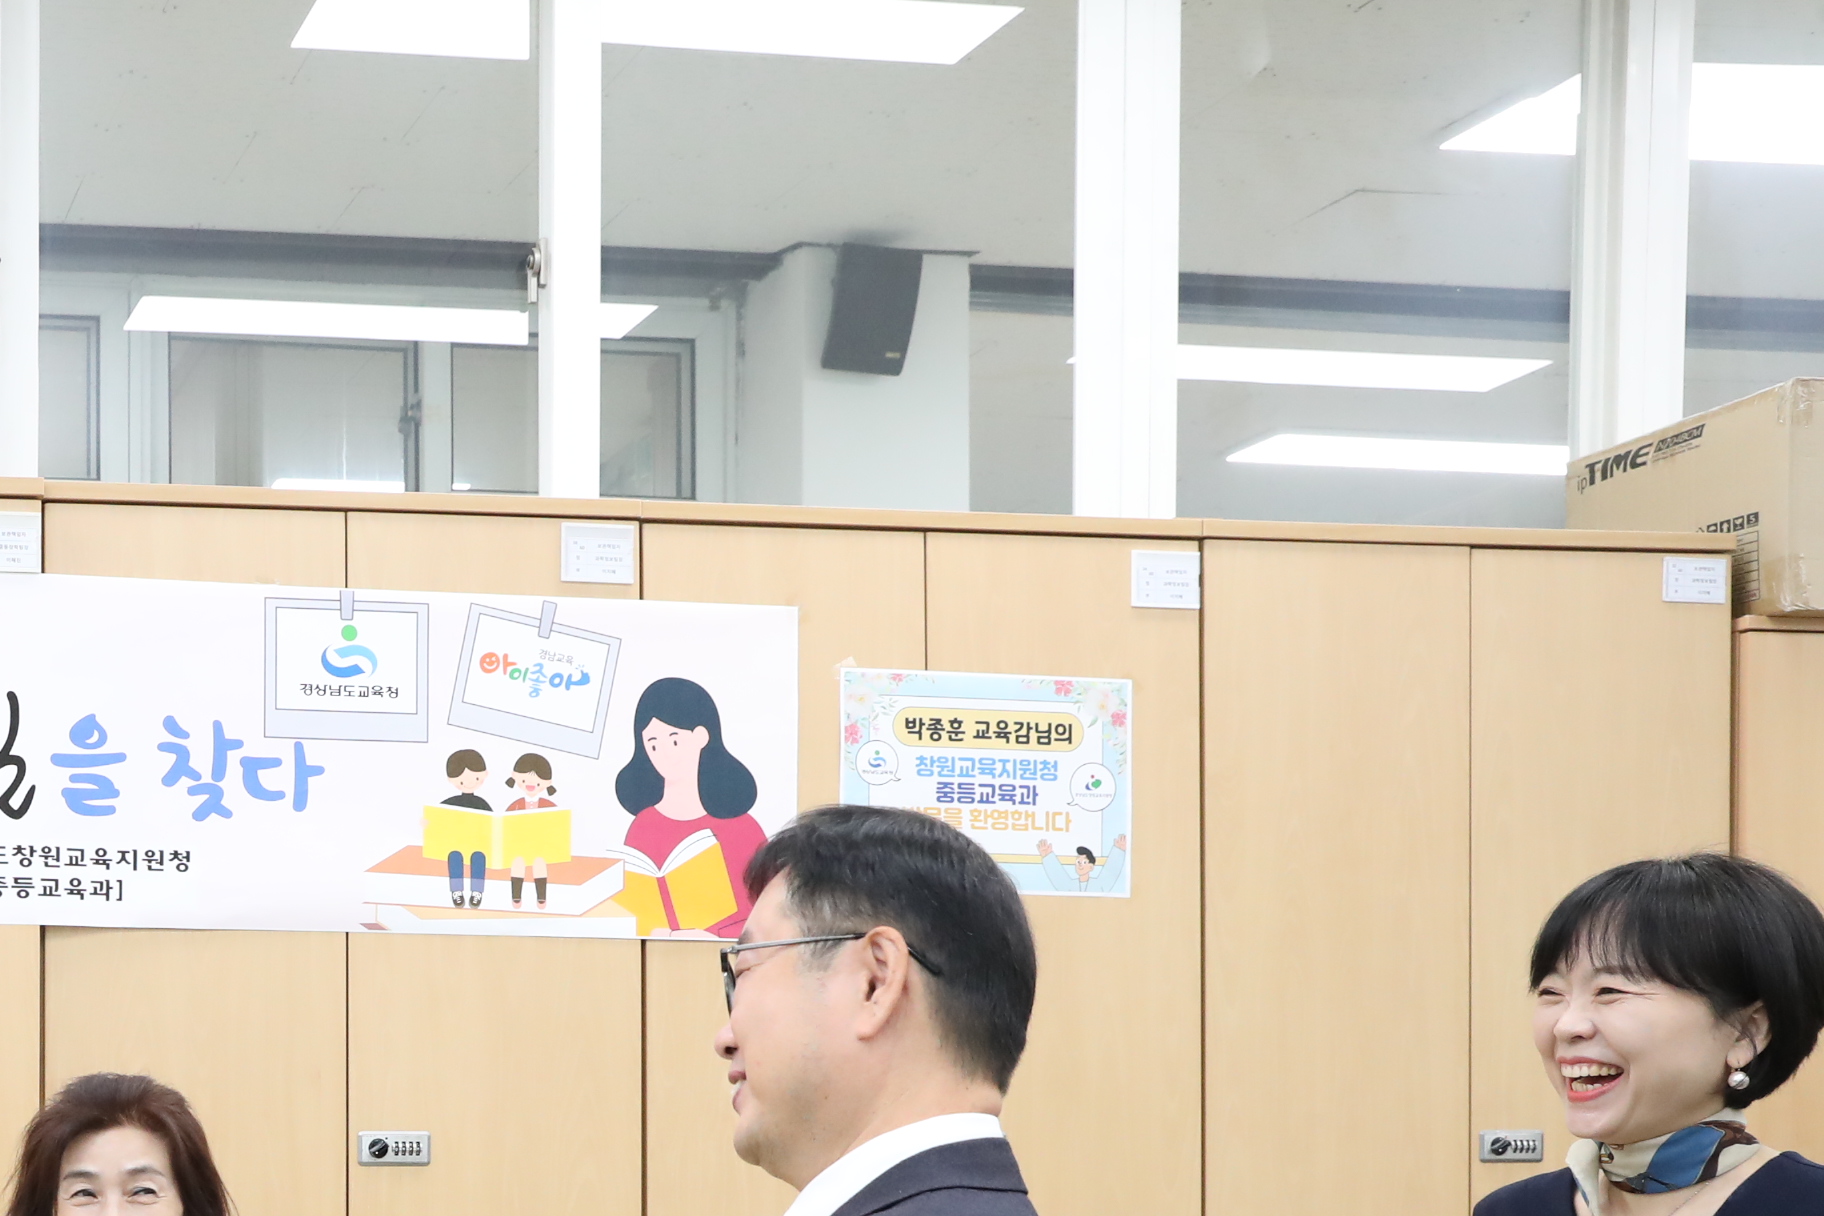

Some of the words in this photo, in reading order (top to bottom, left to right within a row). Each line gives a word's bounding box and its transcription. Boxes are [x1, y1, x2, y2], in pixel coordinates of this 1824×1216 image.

[539, 648, 574, 666] 경남교육
[299, 683, 399, 699] 경상남도교육청
[904, 717, 966, 742] 박종훈
[972, 720, 1073, 745] 교육감님의
[156, 714, 326, 822] 찾다
[915, 755, 1058, 782] 창원교육지원청
[936, 781, 1039, 806] 중등교육과
[969, 808, 1072, 833] 환영합니다
